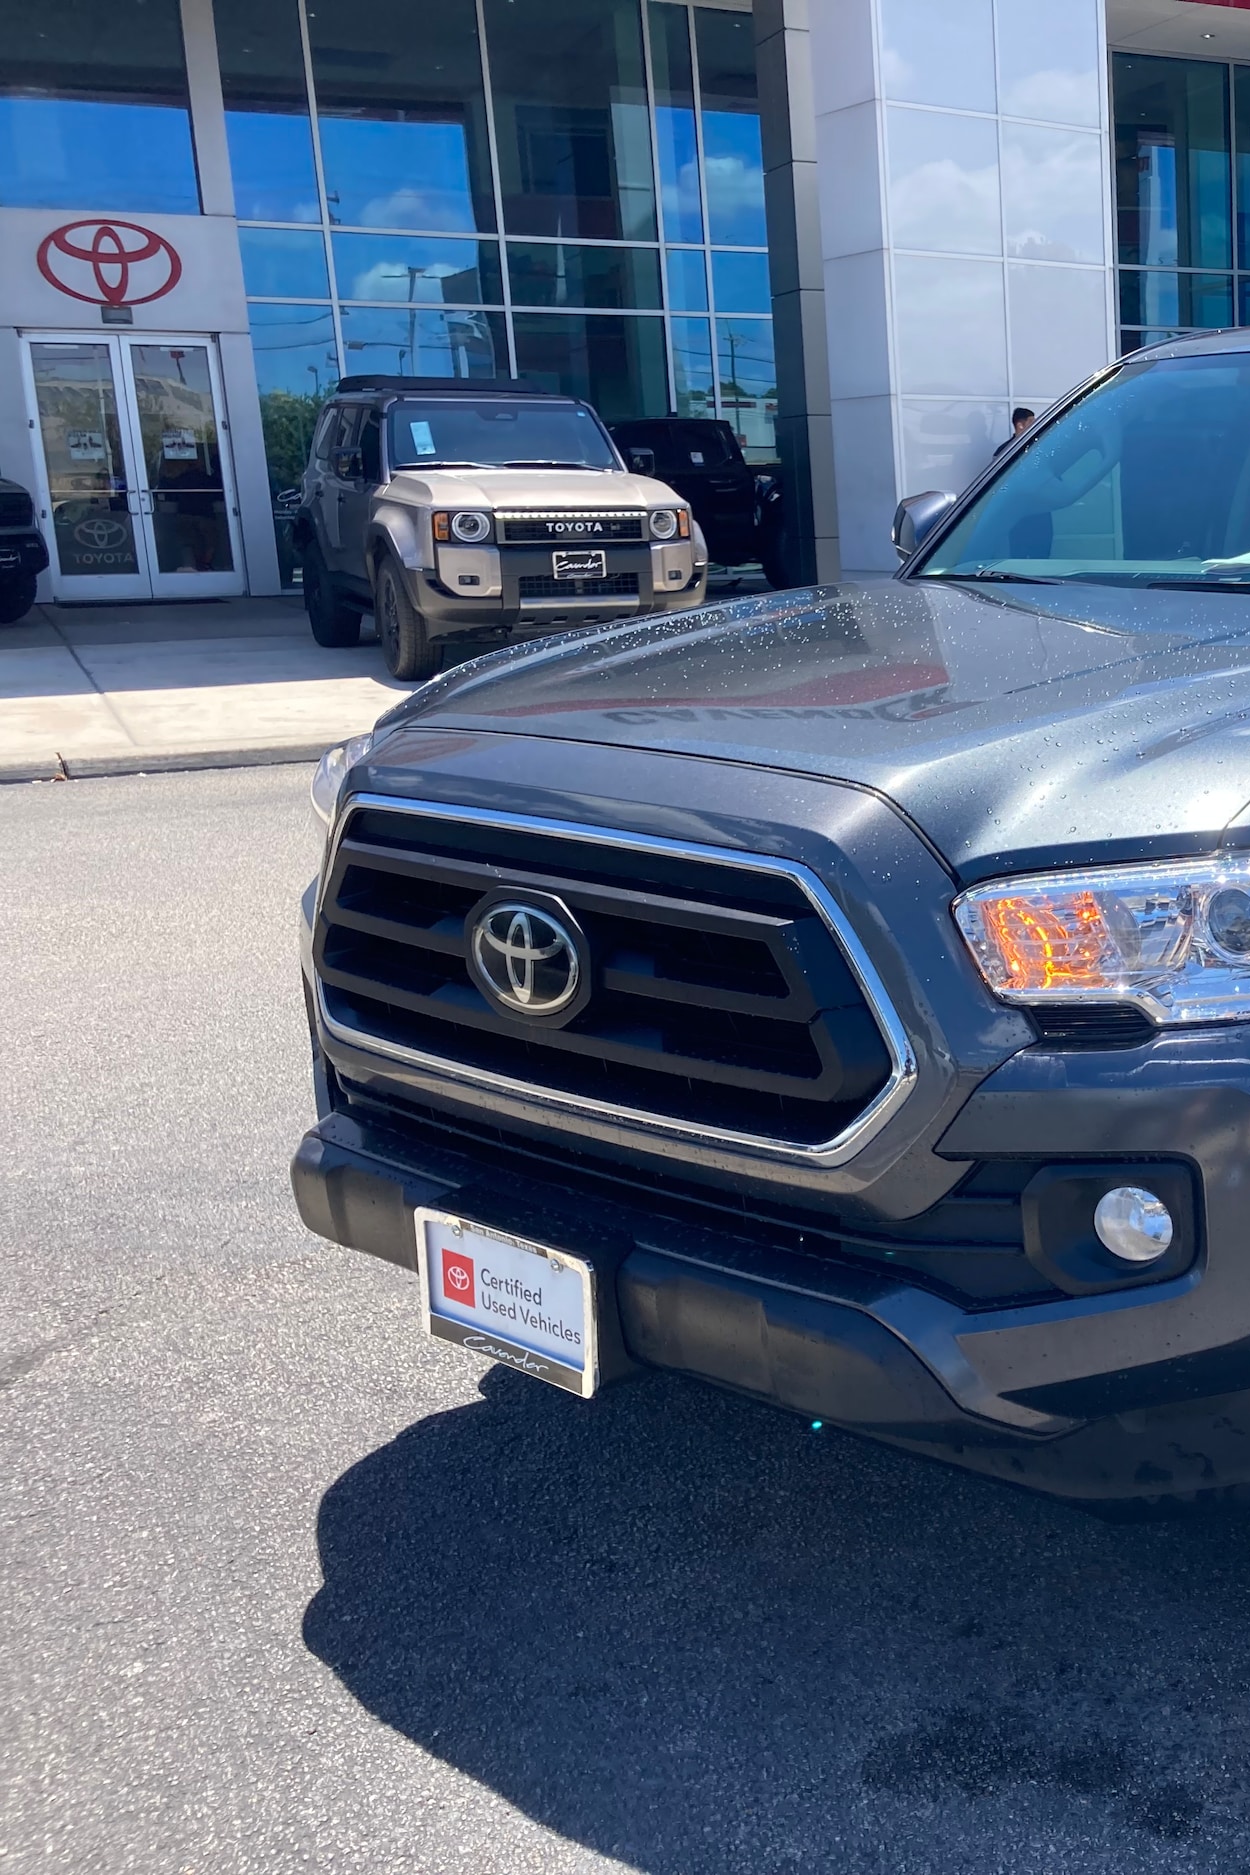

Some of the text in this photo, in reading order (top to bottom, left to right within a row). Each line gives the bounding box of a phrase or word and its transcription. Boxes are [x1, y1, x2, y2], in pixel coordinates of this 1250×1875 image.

[546, 522, 603, 533] TOYOTA
[73, 552, 135, 565] TOYOTA
[470, 1224, 485, 1235] San
[516, 1240, 538, 1254] Texas
[480, 1268, 542, 1306] Certified
[481, 1291, 581, 1345] Used Vehicles
